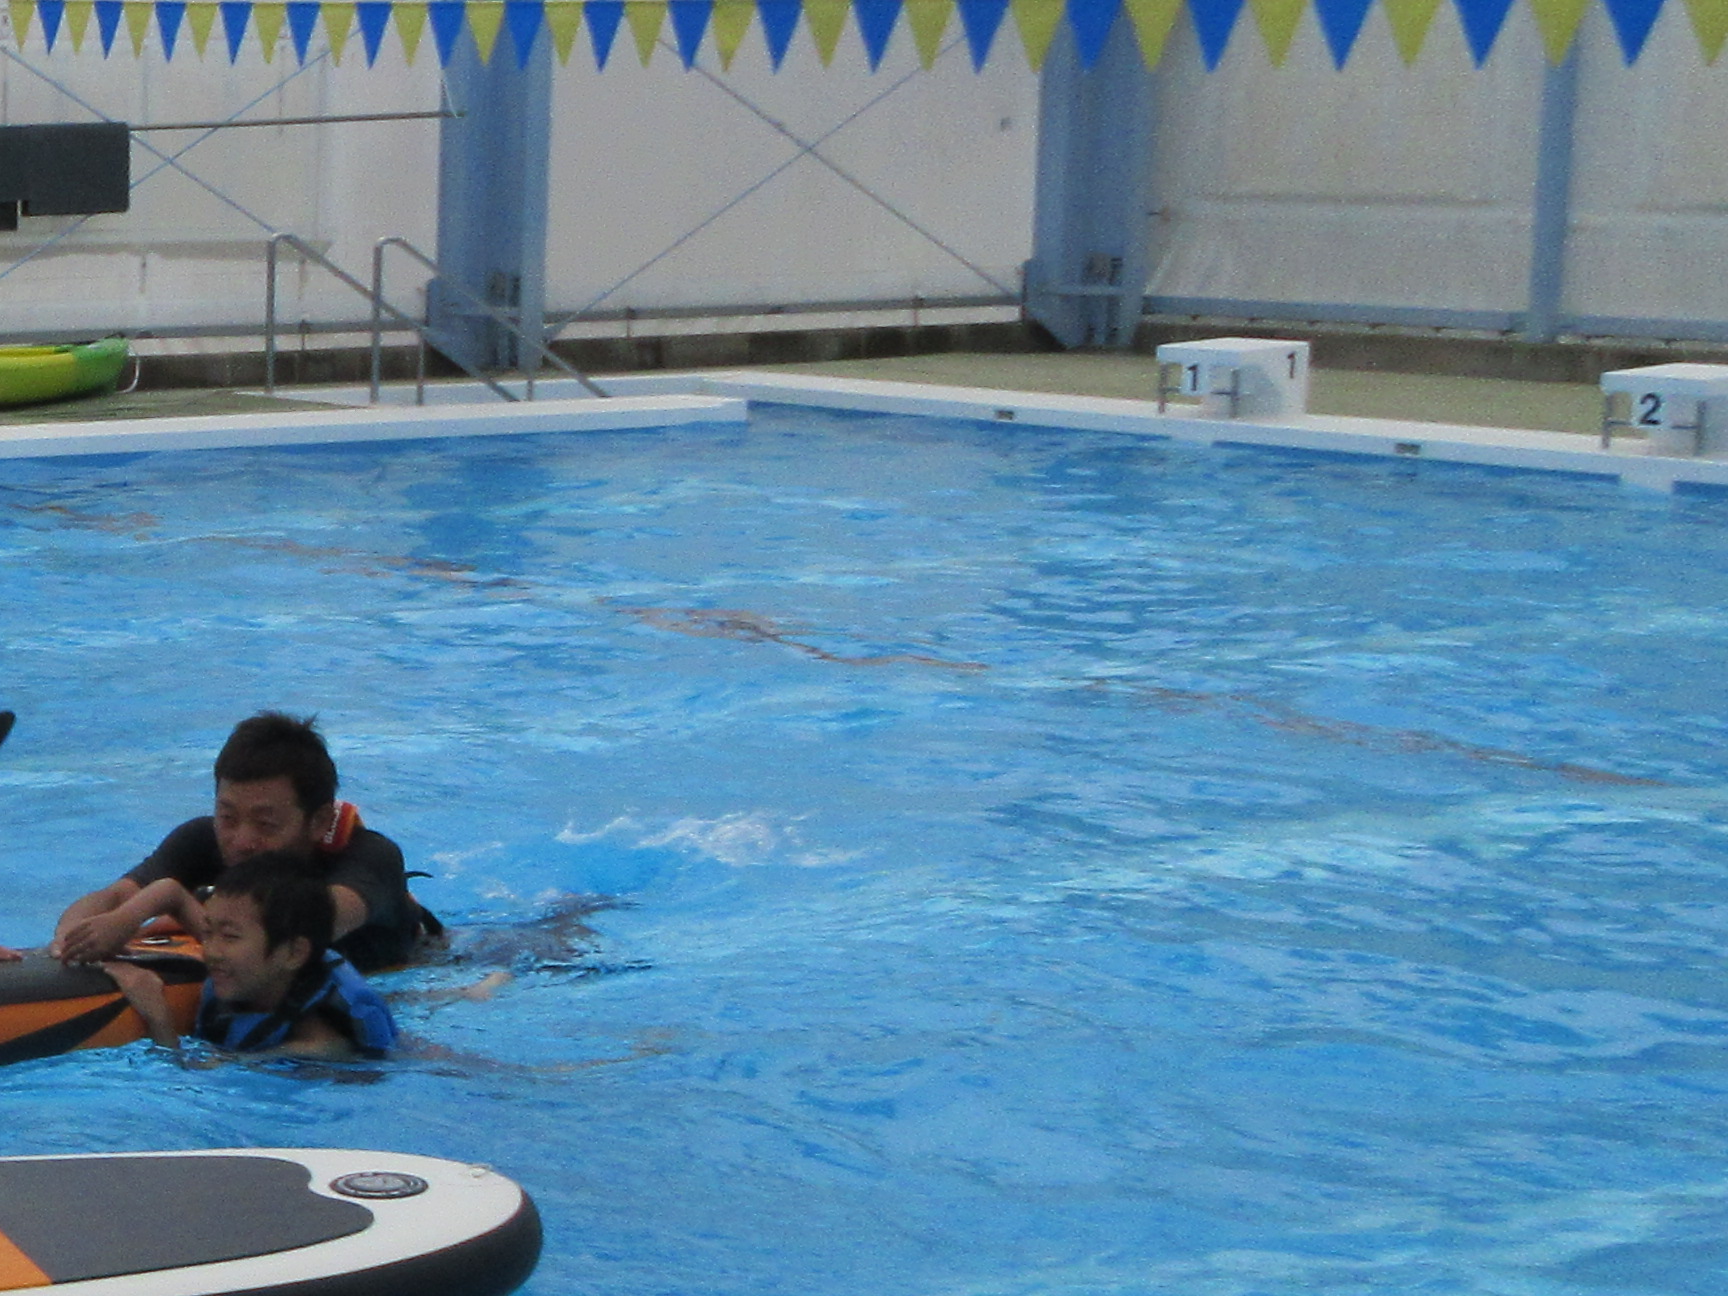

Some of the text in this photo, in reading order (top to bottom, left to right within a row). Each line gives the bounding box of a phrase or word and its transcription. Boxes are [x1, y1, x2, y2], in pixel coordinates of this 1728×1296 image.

[1185, 364, 1199, 392] 1
[1286, 352, 1296, 380] 1
[1639, 393, 1663, 426] 2
